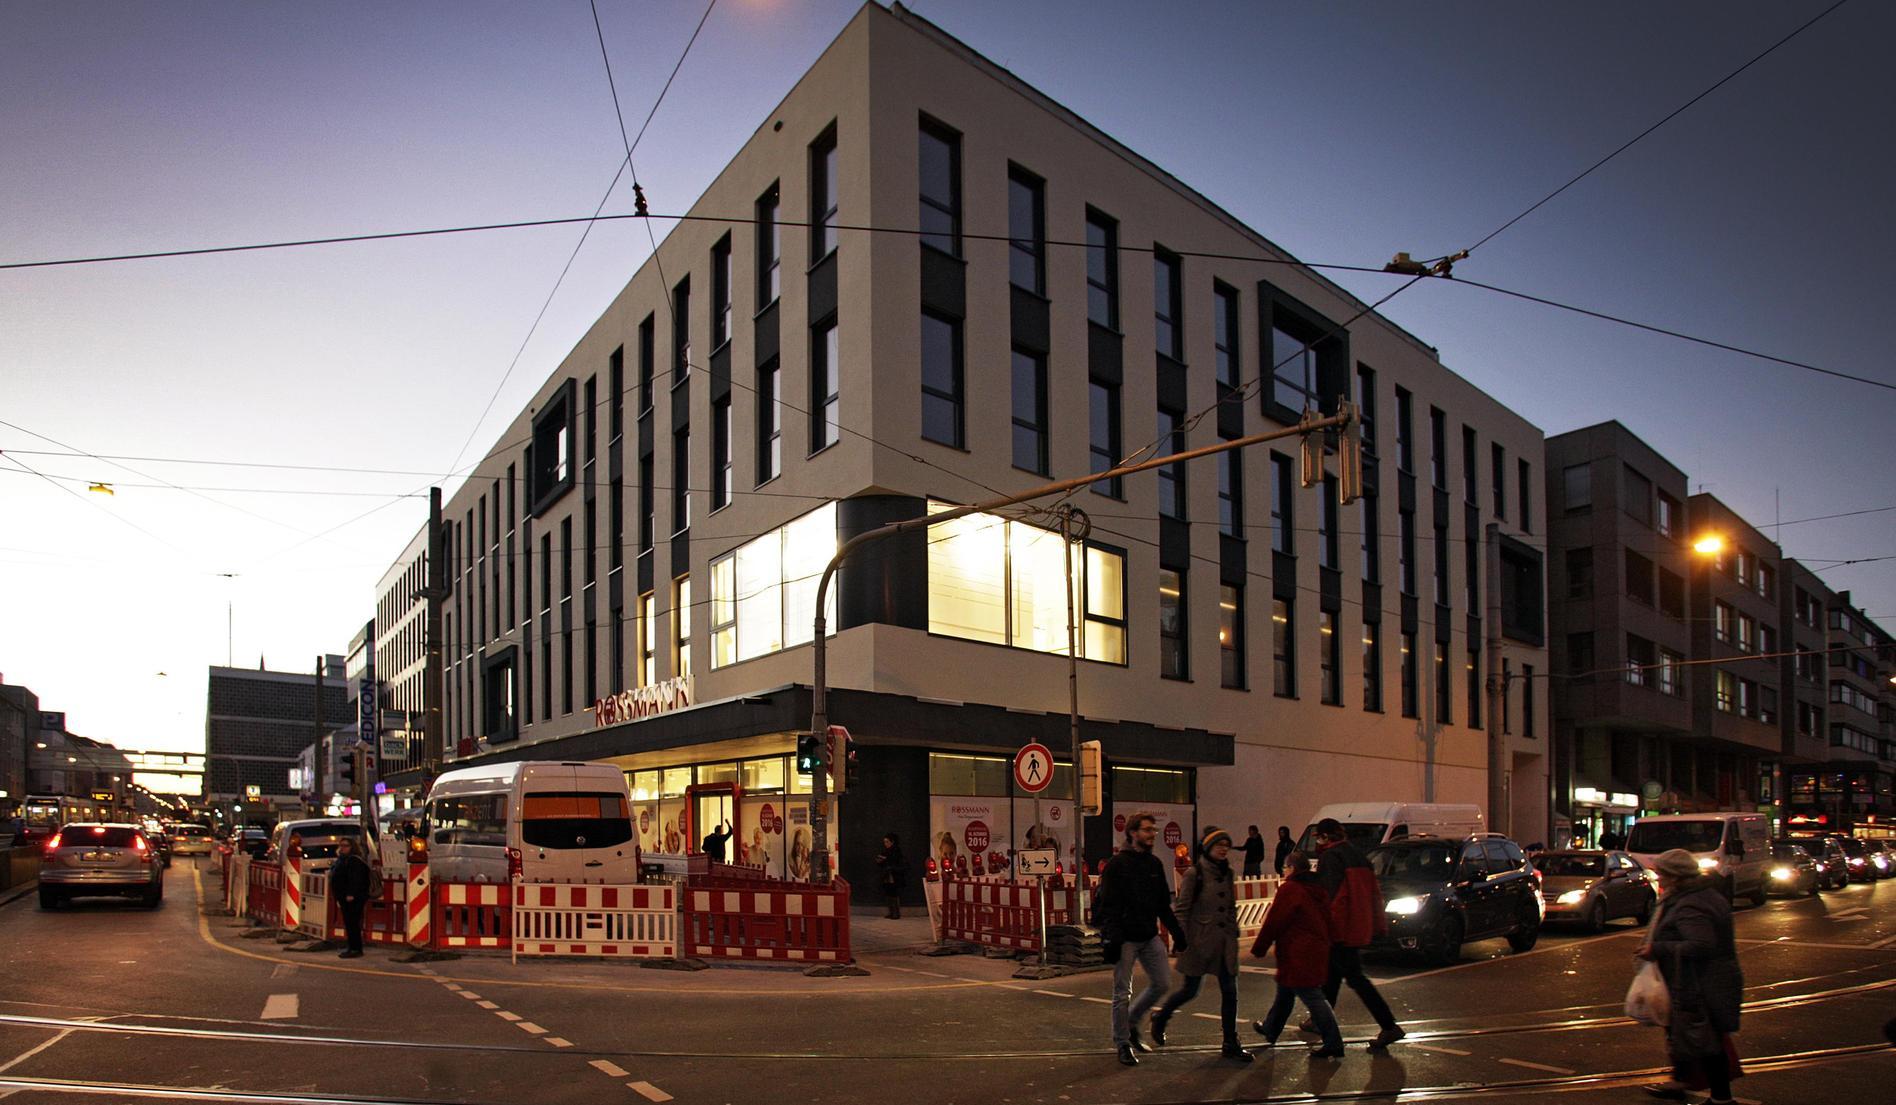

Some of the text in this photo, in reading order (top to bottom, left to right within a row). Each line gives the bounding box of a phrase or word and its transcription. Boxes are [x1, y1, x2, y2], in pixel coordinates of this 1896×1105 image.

[595, 674, 695, 728] ROSSMANN
[951, 806, 990, 814] ROSSMANN
[967, 836, 987, 847] 2016
[1165, 835, 1180, 844] 2016
